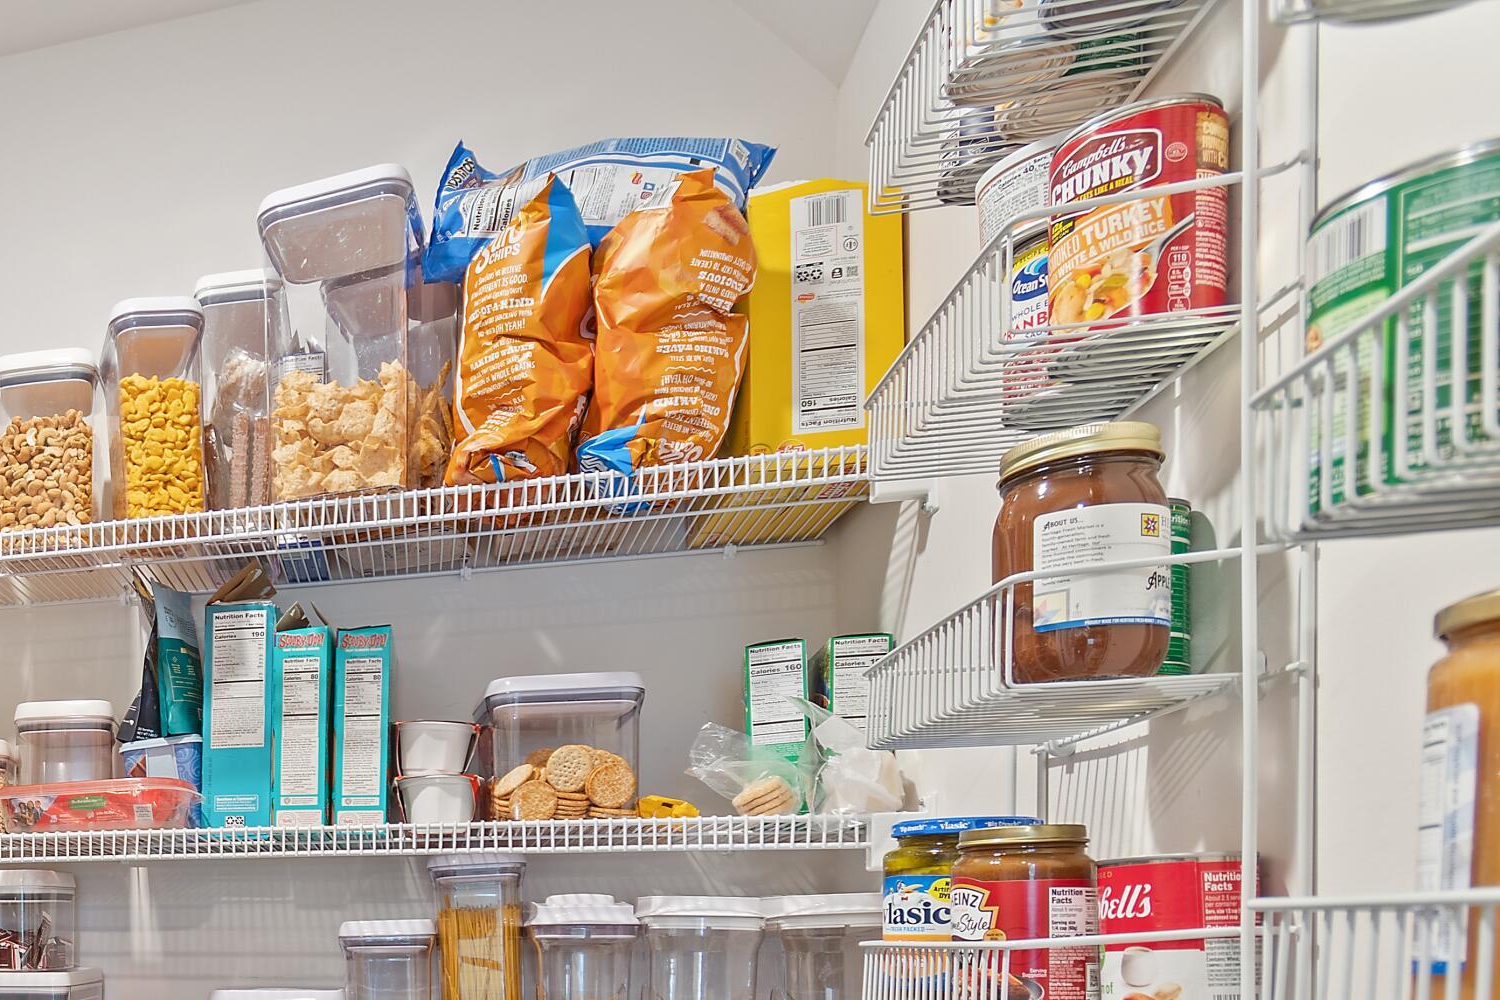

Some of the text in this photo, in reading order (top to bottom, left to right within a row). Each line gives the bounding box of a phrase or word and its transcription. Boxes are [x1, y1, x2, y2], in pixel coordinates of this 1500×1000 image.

[1063, 135, 1127, 179] Campbell's
[1051, 146, 1154, 208] CHUNKY
[1094, 183, 1108, 197] LIKE
[1115, 176, 1134, 188] MEAL
[473, 197, 487, 231] Nutrition
[499, 198, 512, 231] Calories
[1083, 195, 1166, 246] TURKEY
[488, 242, 520, 265] CHIPS
[1050, 230, 1081, 266] MOKED
[1056, 220, 1166, 279] WHITE & WILD RICE
[1013, 280, 1038, 295] Ocean
[1012, 303, 1042, 322] WHOLE
[801, 399, 817, 408] 160
[801, 419, 822, 427] Facts
[1043, 519, 1067, 531] ABOUT
[214, 613, 244, 621] Nutrition
[750, 643, 801, 654] Nutrition Facts
[750, 663, 802, 675] Calories 160
[1204, 872, 1241, 882] Nutritio
[1204, 883, 1233, 891] Facts
[1100, 883, 1152, 919] bell's
